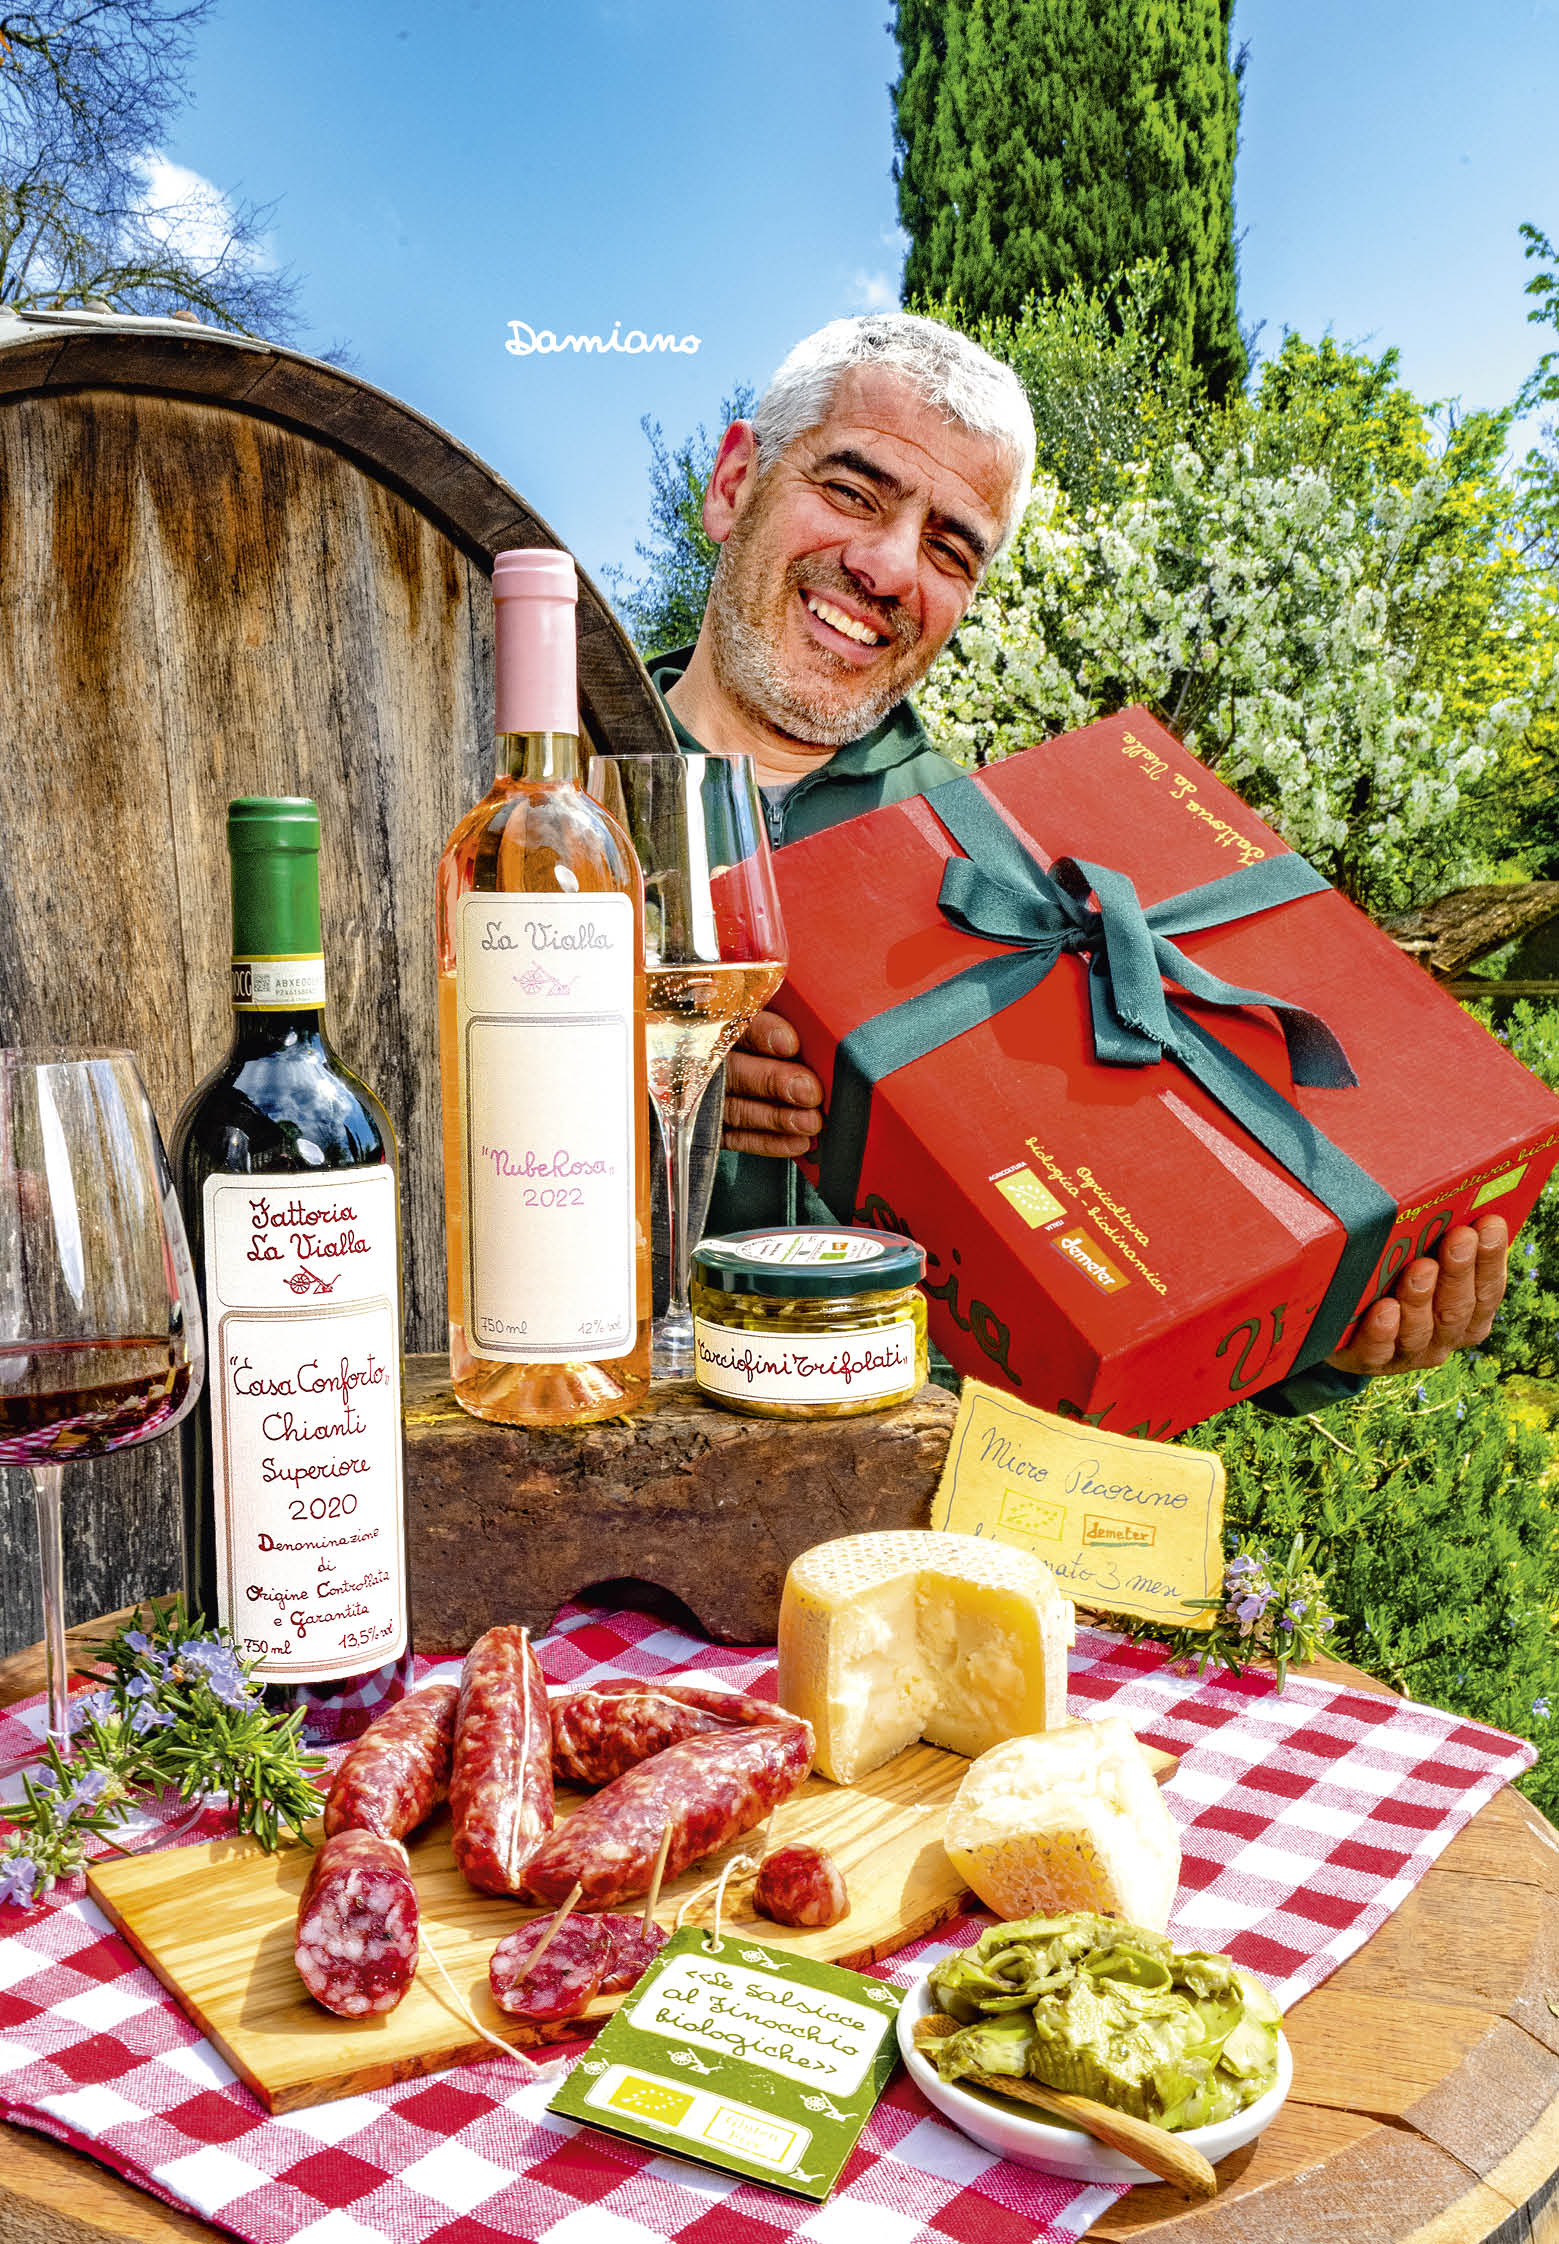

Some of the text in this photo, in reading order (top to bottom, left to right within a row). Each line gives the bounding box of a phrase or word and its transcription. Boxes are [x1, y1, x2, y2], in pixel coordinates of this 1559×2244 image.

[1122, 731, 1169, 781] Vialla
[481, 921, 615, 951] La Vialla
[249, 1196, 358, 1230] Fattoria
[522, 1187, 585, 1208] 2022
[1076, 1167, 1150, 1247] Agricoltura
[1025, 1136, 1080, 1198] biologica
[1088, 1206, 1168, 1296] biodinamica
[247, 1229, 371, 1262] La Vialla
[1061, 1237, 1117, 1286] demeter
[262, 1406, 367, 1442] Chianti
[261, 1456, 371, 1489] Superiore
[980, 1426, 1189, 1509] Micro Pecorino
[288, 1493, 358, 1520] 2020
[257, 1528, 380, 1553] Denominazione
[1087, 1521, 1150, 1541] demeter
[317, 1556, 337, 1573] di
[1095, 1560, 1121, 1591] 3
[246, 1568, 391, 1611] Origine Controllata
[273, 1602, 370, 1639] e Garantita
[662, 1987, 860, 2057] al Finocchio
[744, 1983, 867, 2032] Salsicce
